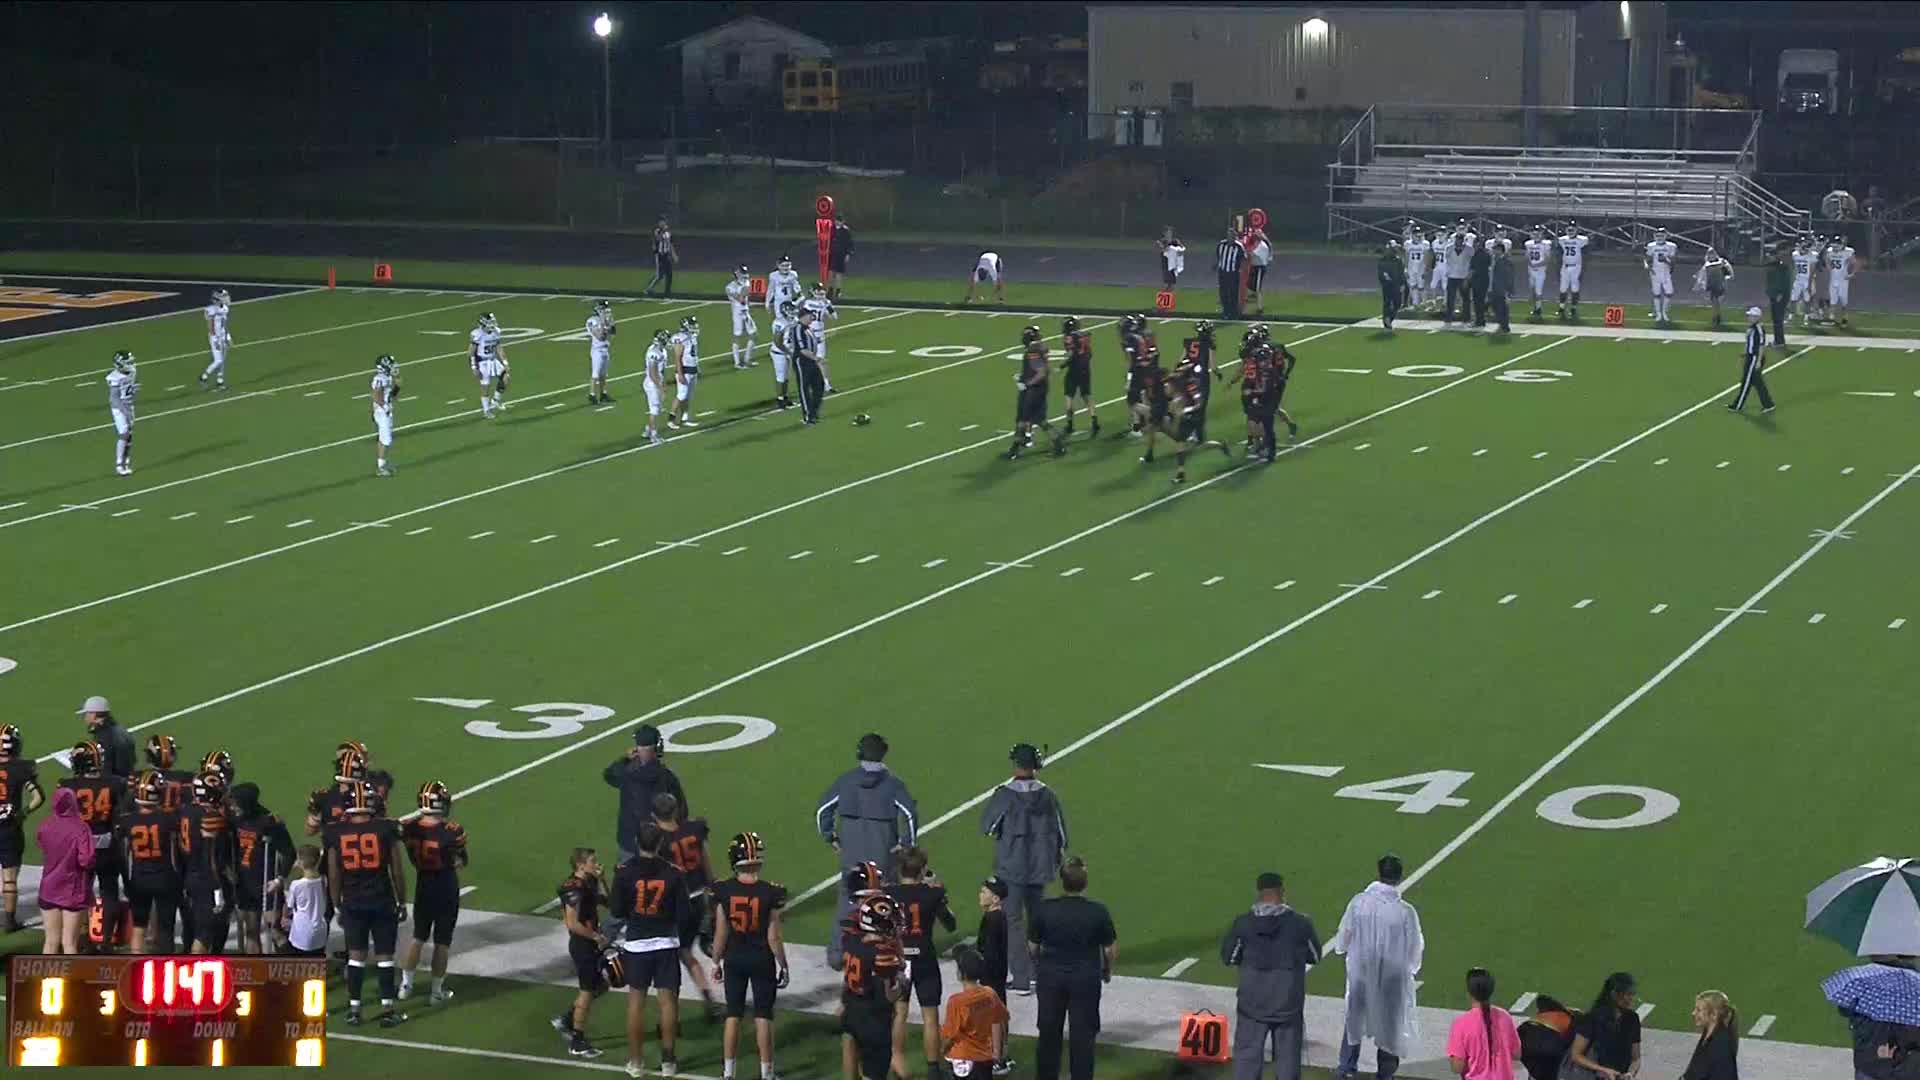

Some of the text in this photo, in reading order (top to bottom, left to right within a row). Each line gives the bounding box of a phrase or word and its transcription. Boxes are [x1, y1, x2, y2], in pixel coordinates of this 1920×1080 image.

[751, 280, 762, 292] 10
[1157, 294, 1170, 309] 20
[1607, 308, 1621, 323] 30
[464, 702, 777, 753] 30
[76, 786, 112, 822] 34
[1334, 769, 1681, 829] 40
[131, 823, 162, 860] 21
[340, 833, 381, 870] 59
[635, 880, 665, 916] 17
[729, 895, 760, 933] 51
[1182, 1018, 1221, 1056] 40
